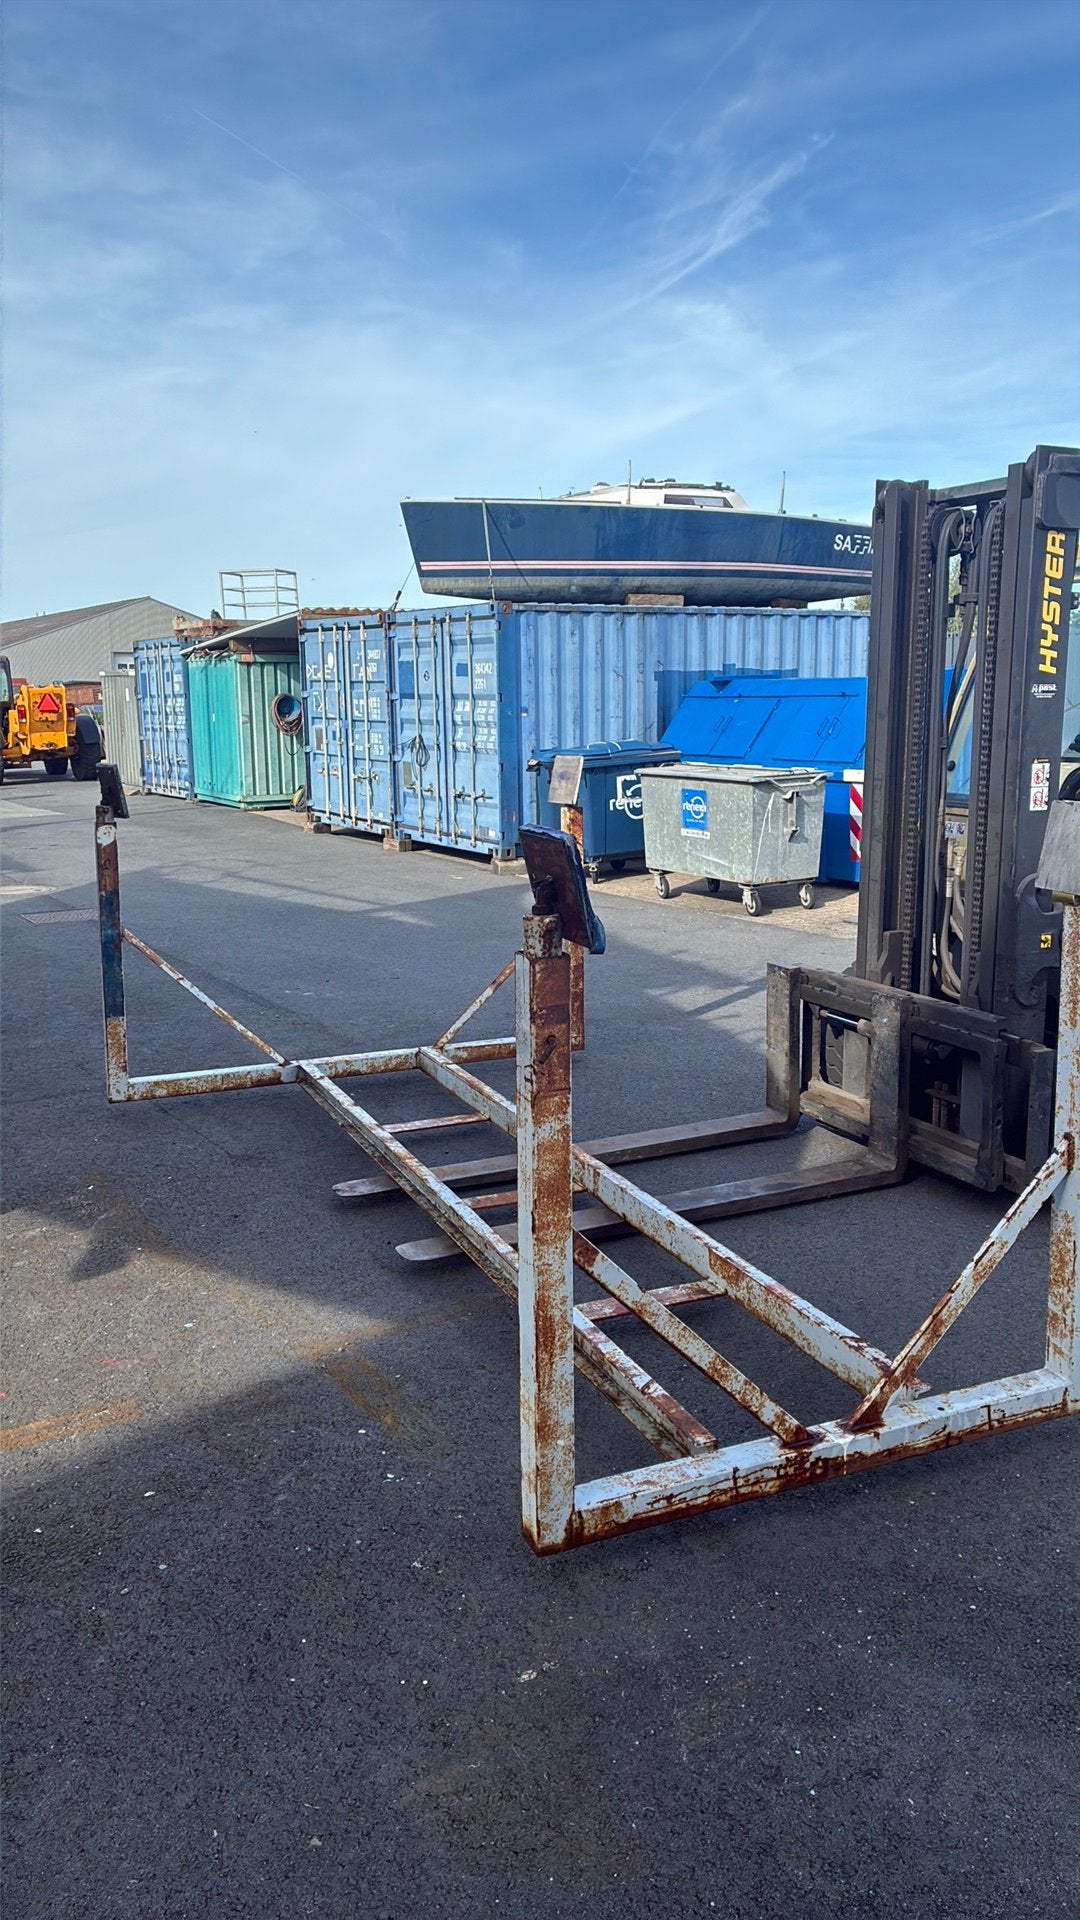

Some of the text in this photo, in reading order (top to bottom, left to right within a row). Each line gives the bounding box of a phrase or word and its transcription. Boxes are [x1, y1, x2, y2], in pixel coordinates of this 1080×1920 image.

[833, 533, 874, 555] SAFFI
[1038, 530, 1066, 674] HYSTER
[609, 797, 643, 811] rene
